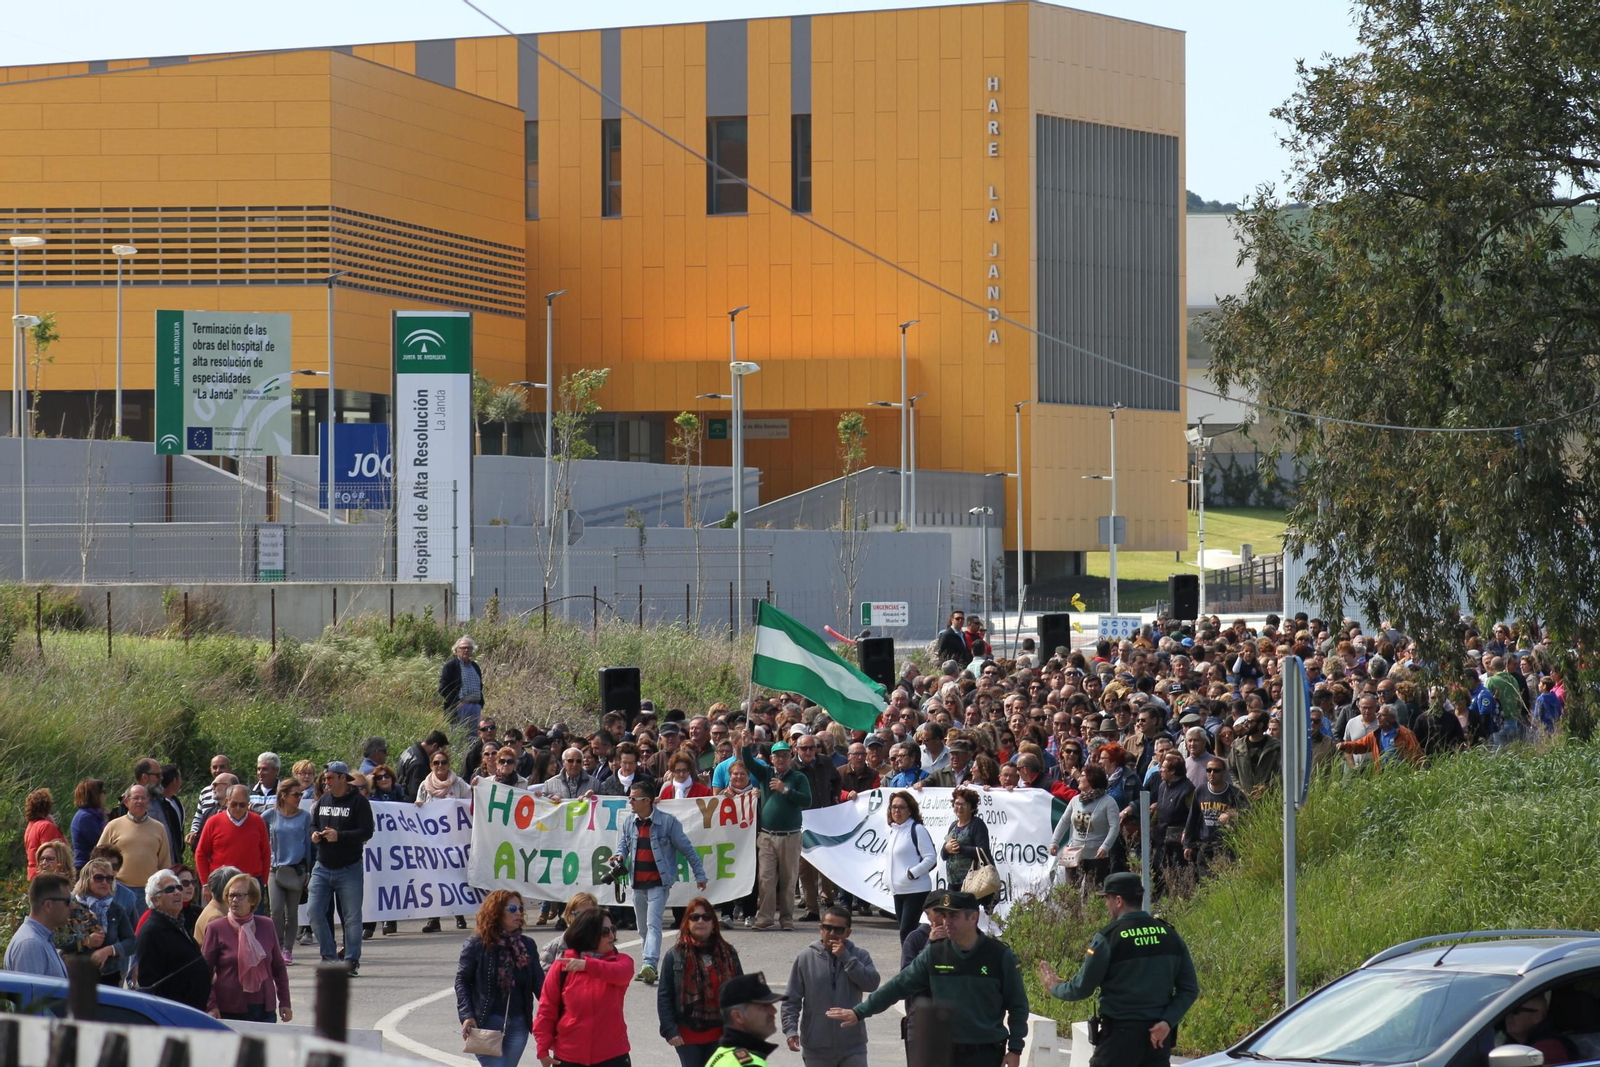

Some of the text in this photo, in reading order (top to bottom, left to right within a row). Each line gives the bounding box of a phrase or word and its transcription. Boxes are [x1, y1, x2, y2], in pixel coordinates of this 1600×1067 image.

[987, 77, 1000, 344] HARE LA JANDA
[192, 322, 268, 335] Terminación de las
[192, 339, 275, 353] obras del hospital de
[173, 356, 180, 365] DE
[192, 355, 264, 368] alta resolución de
[192, 372, 251, 385] especialidades
[434, 389, 446, 431] La Janda
[413, 389, 428, 467] Resolución
[413, 471, 428, 500] Alta
[413, 504, 428, 522] de
[983, 794, 993, 806] se
[373, 805, 473, 836] ra de los A
[986, 809, 1008, 825] 2010
[365, 846, 382, 873] N
[378, 878, 434, 912] MÁS
[1120, 926, 1168, 939] GUARDIA
[1134, 935, 1161, 947] CIVIL
